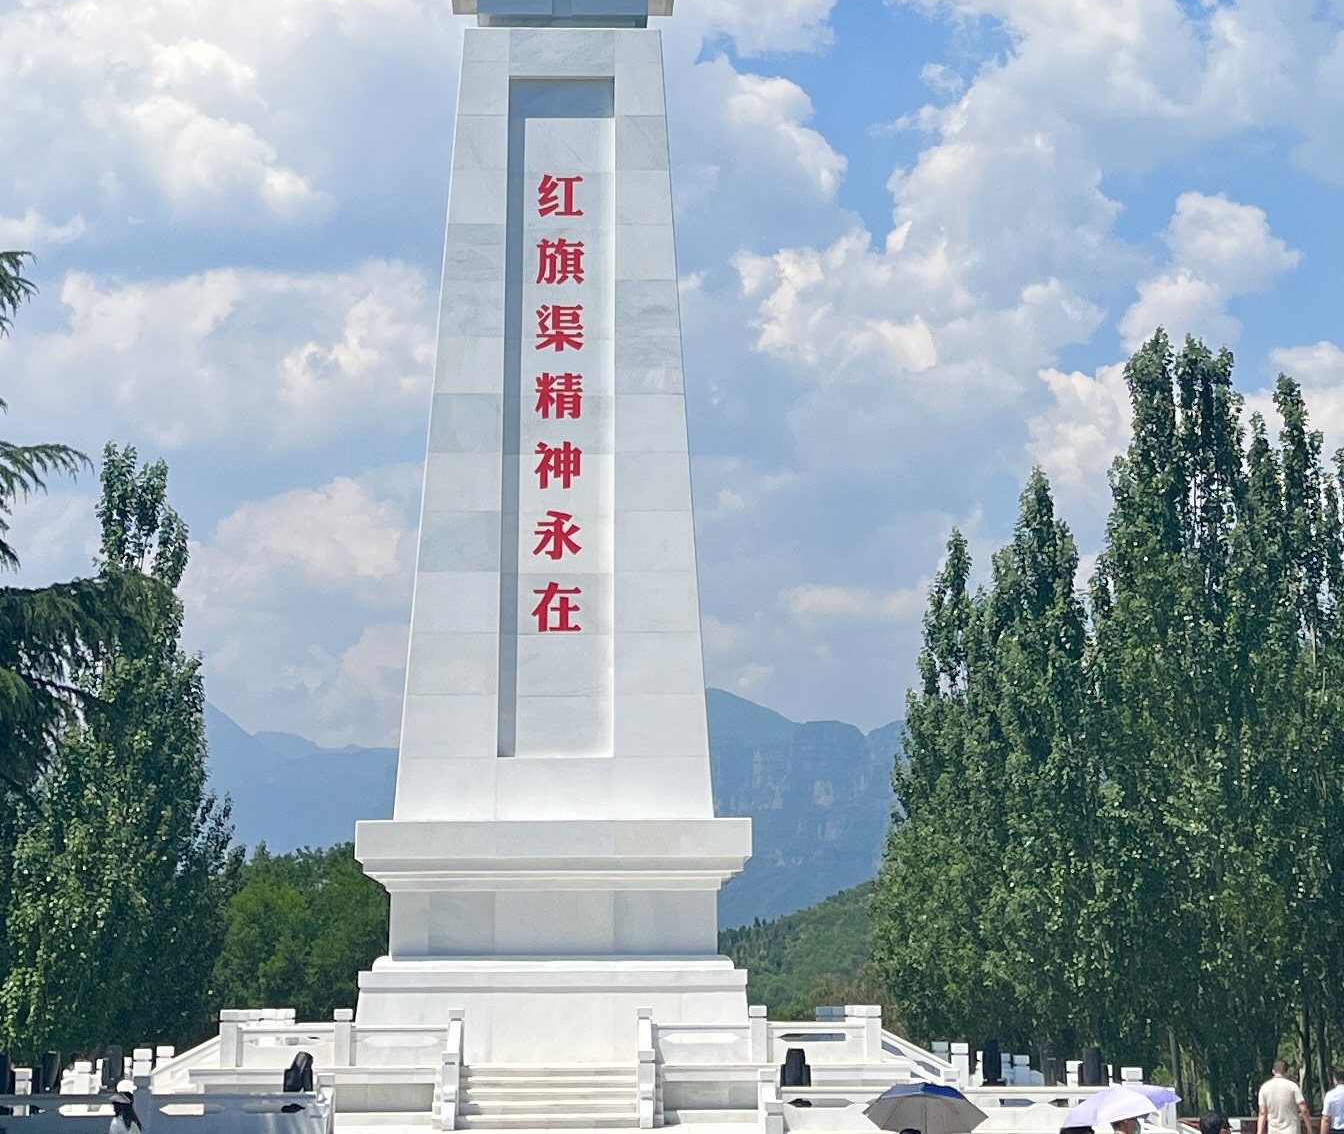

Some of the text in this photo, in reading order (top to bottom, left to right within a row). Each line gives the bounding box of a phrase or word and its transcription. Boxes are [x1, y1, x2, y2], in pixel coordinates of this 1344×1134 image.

[532, 173, 585, 633] 红旗渠精神永在
